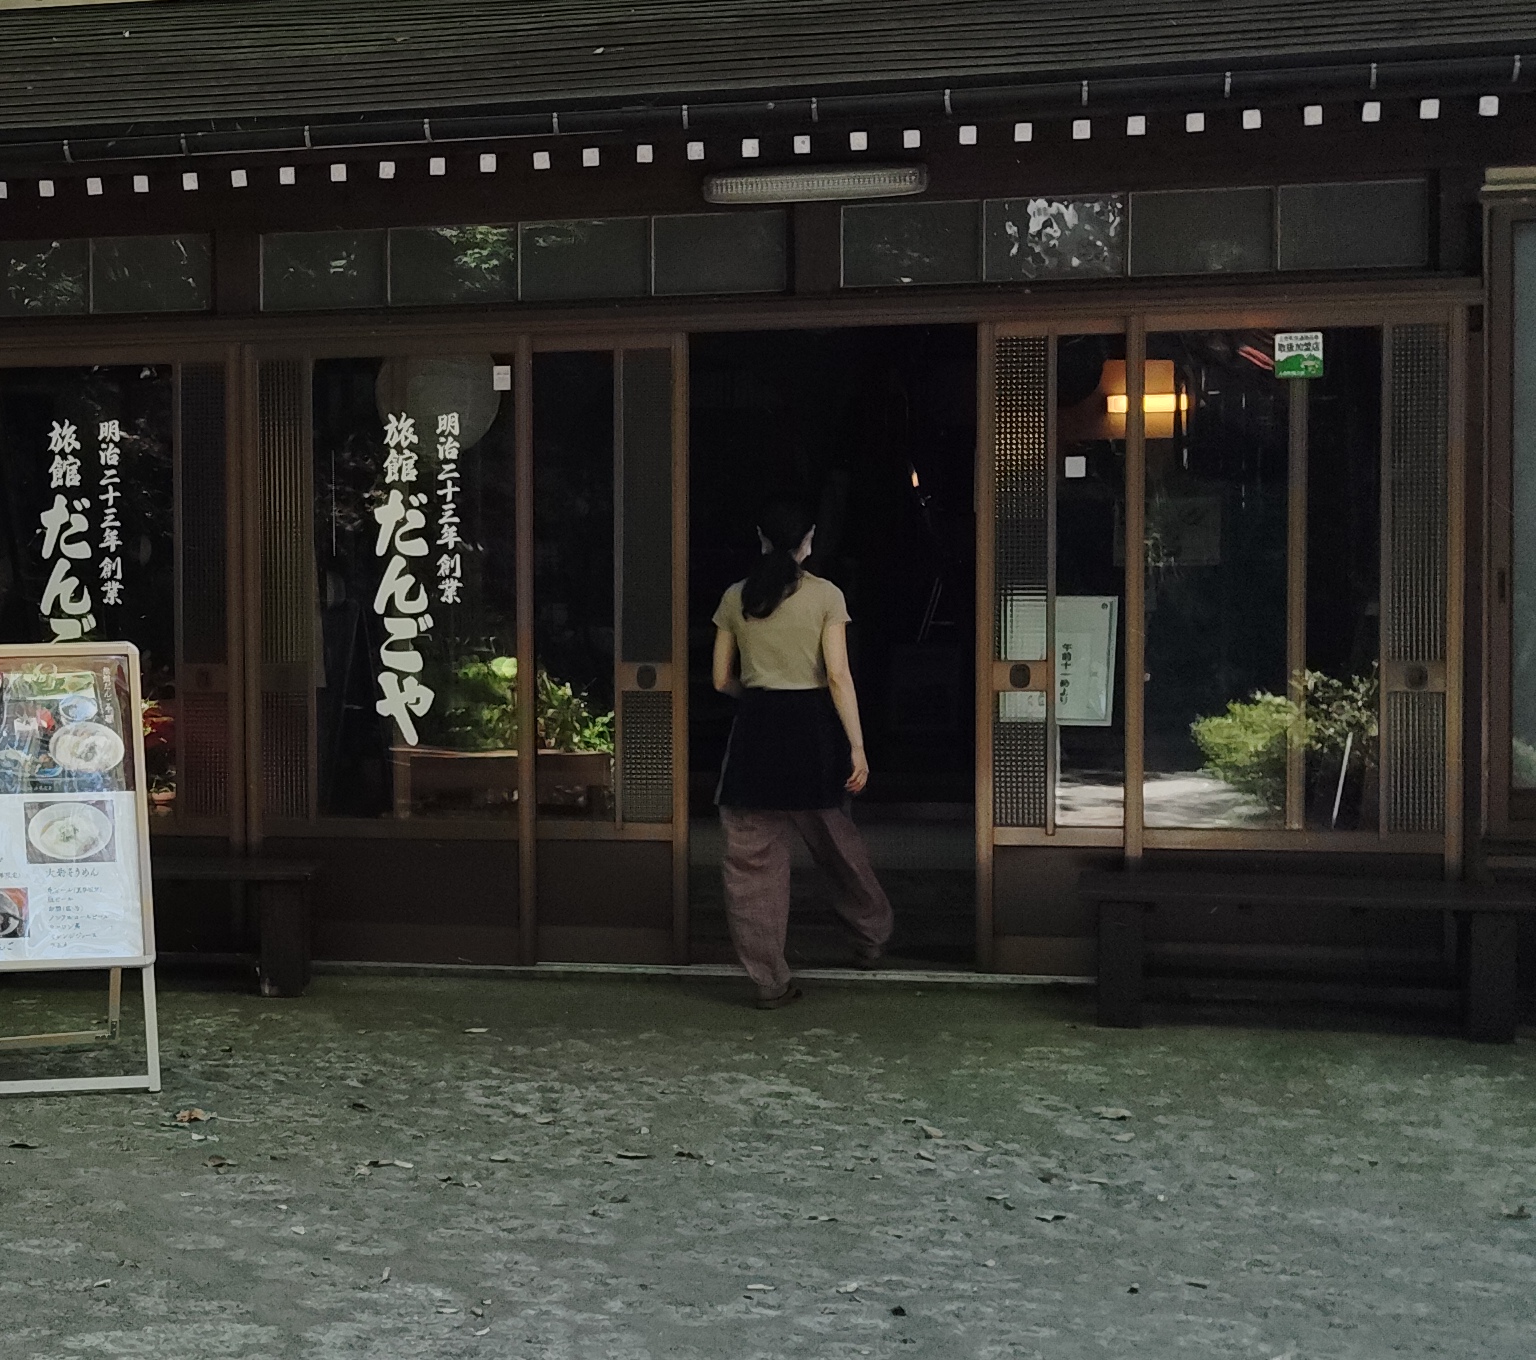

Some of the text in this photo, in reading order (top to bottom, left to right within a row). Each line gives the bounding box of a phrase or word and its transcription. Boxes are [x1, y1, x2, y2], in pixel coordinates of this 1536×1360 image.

[98, 419, 125, 606] 明治二十三年創業
[436, 411, 463, 605] 明治二十三年創業
